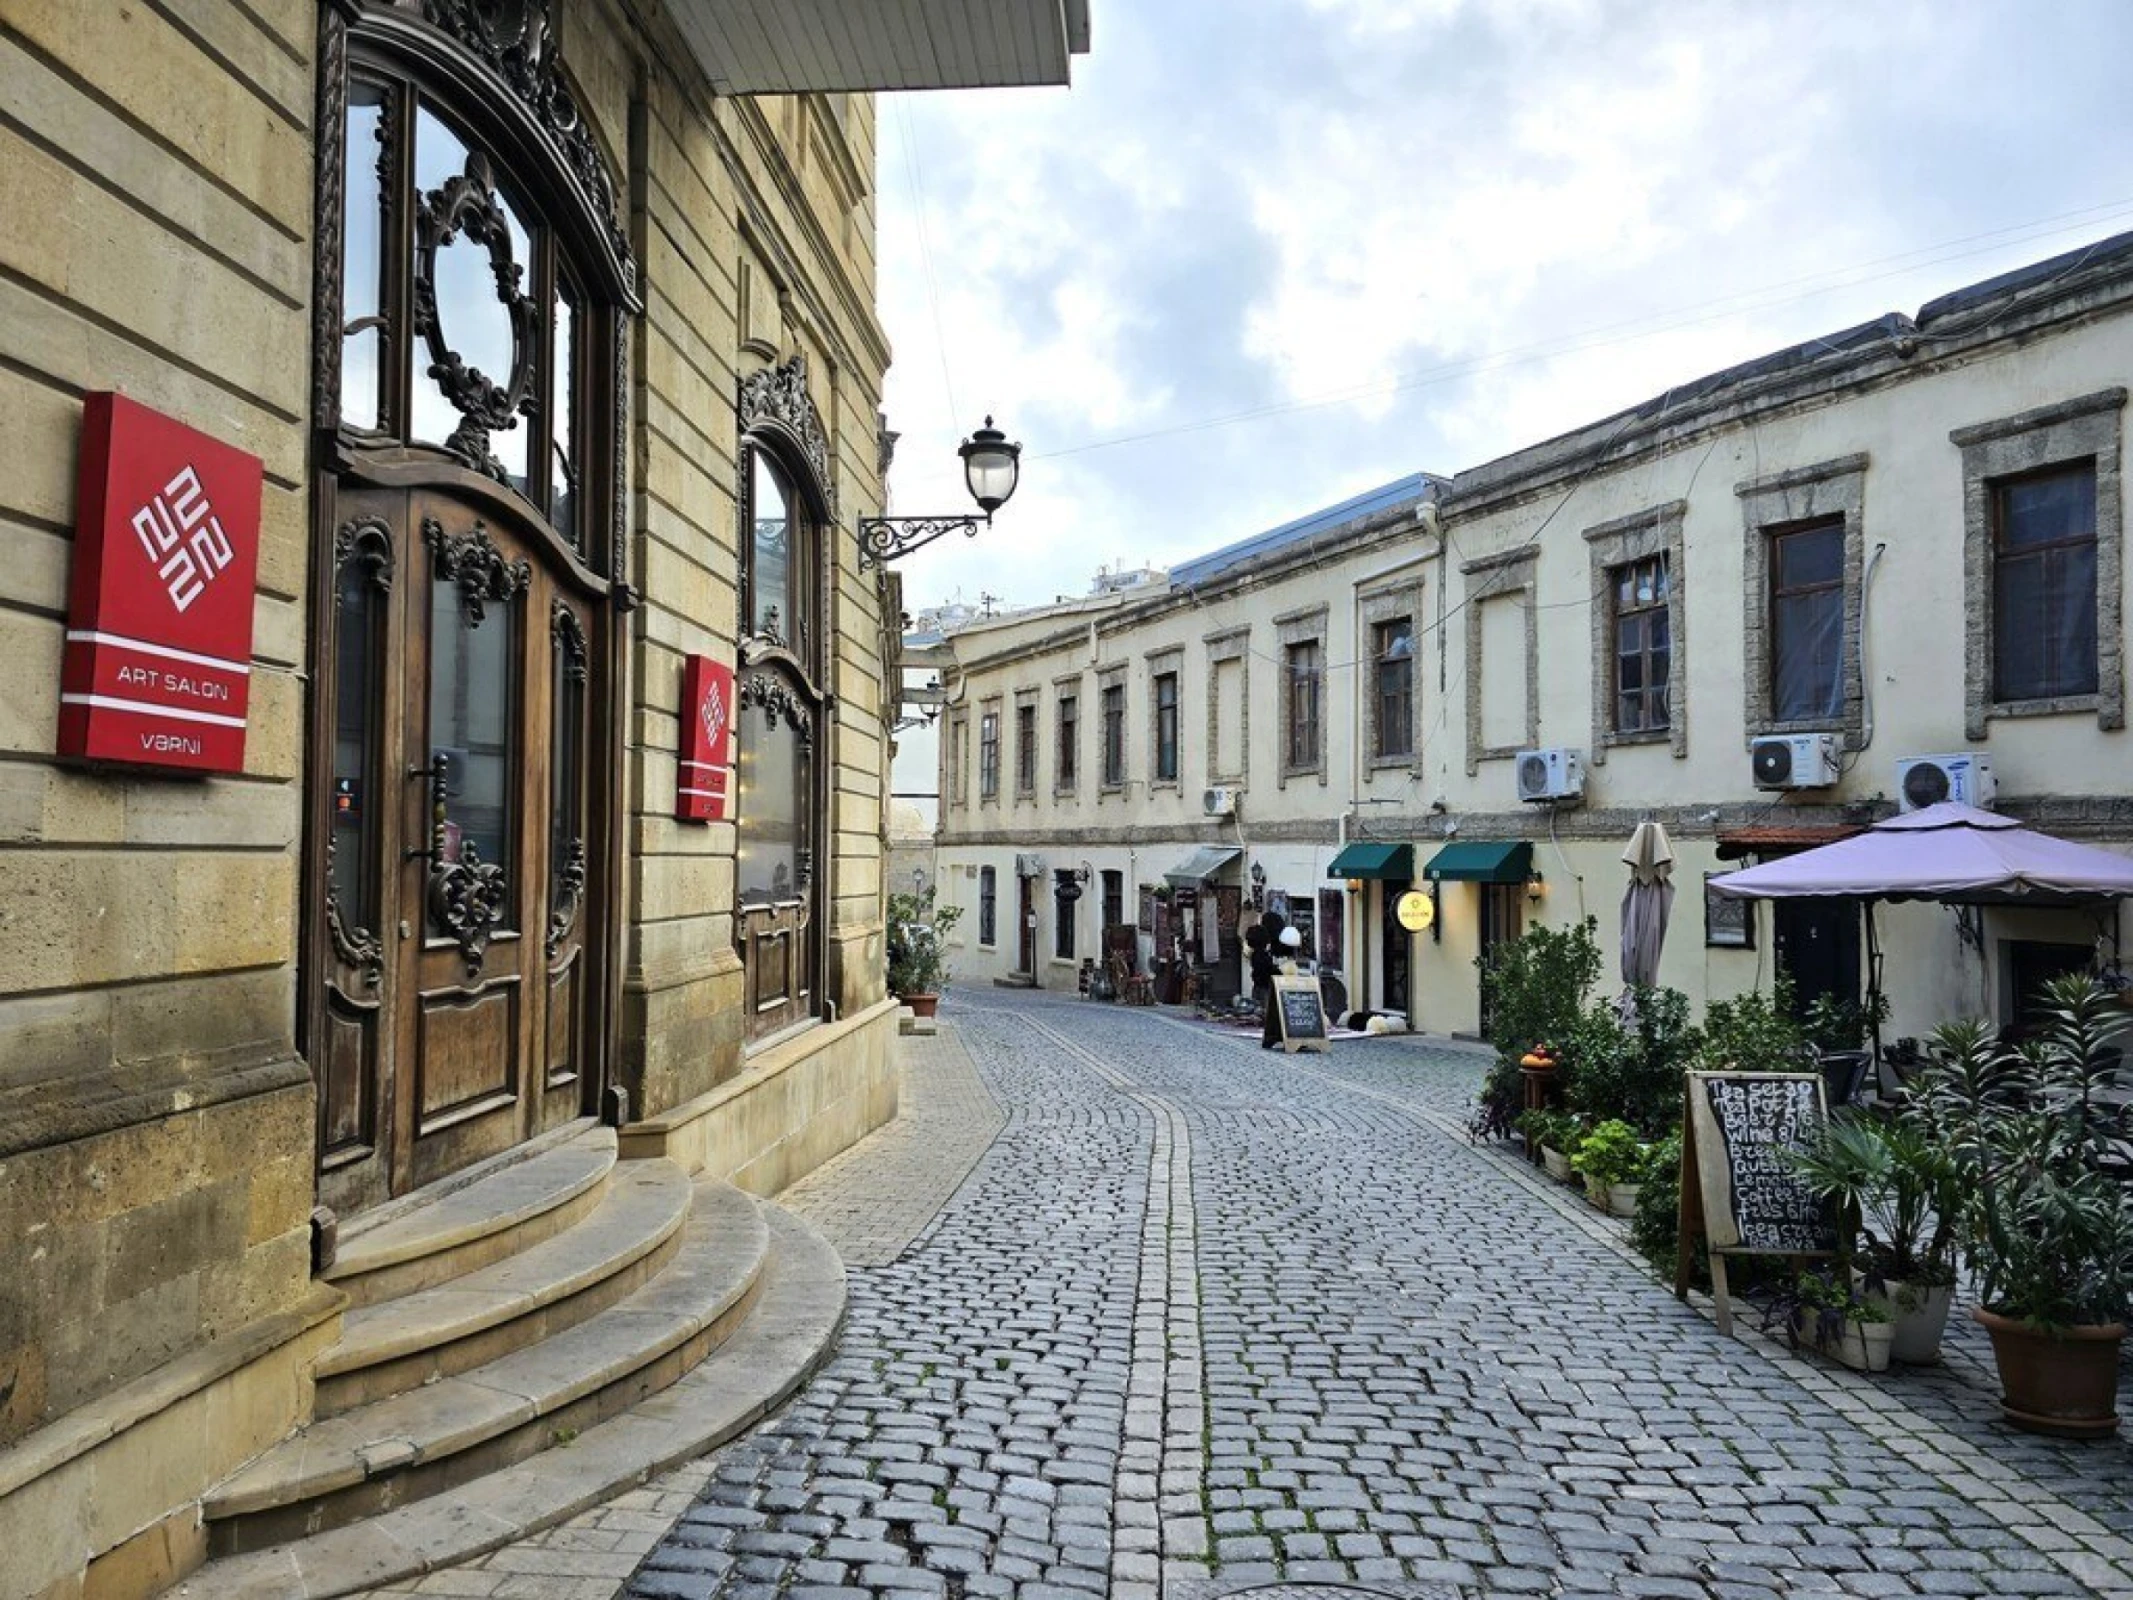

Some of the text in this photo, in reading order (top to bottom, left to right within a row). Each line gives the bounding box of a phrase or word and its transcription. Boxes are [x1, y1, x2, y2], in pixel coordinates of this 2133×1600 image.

[117, 666, 229, 701] ART SALON
[1707, 1078, 1746, 1100] Tea
[1713, 1097, 1747, 1113] Tea
[1725, 1124, 1774, 1143] Wine
[1736, 1186, 1793, 1205] Coffee
